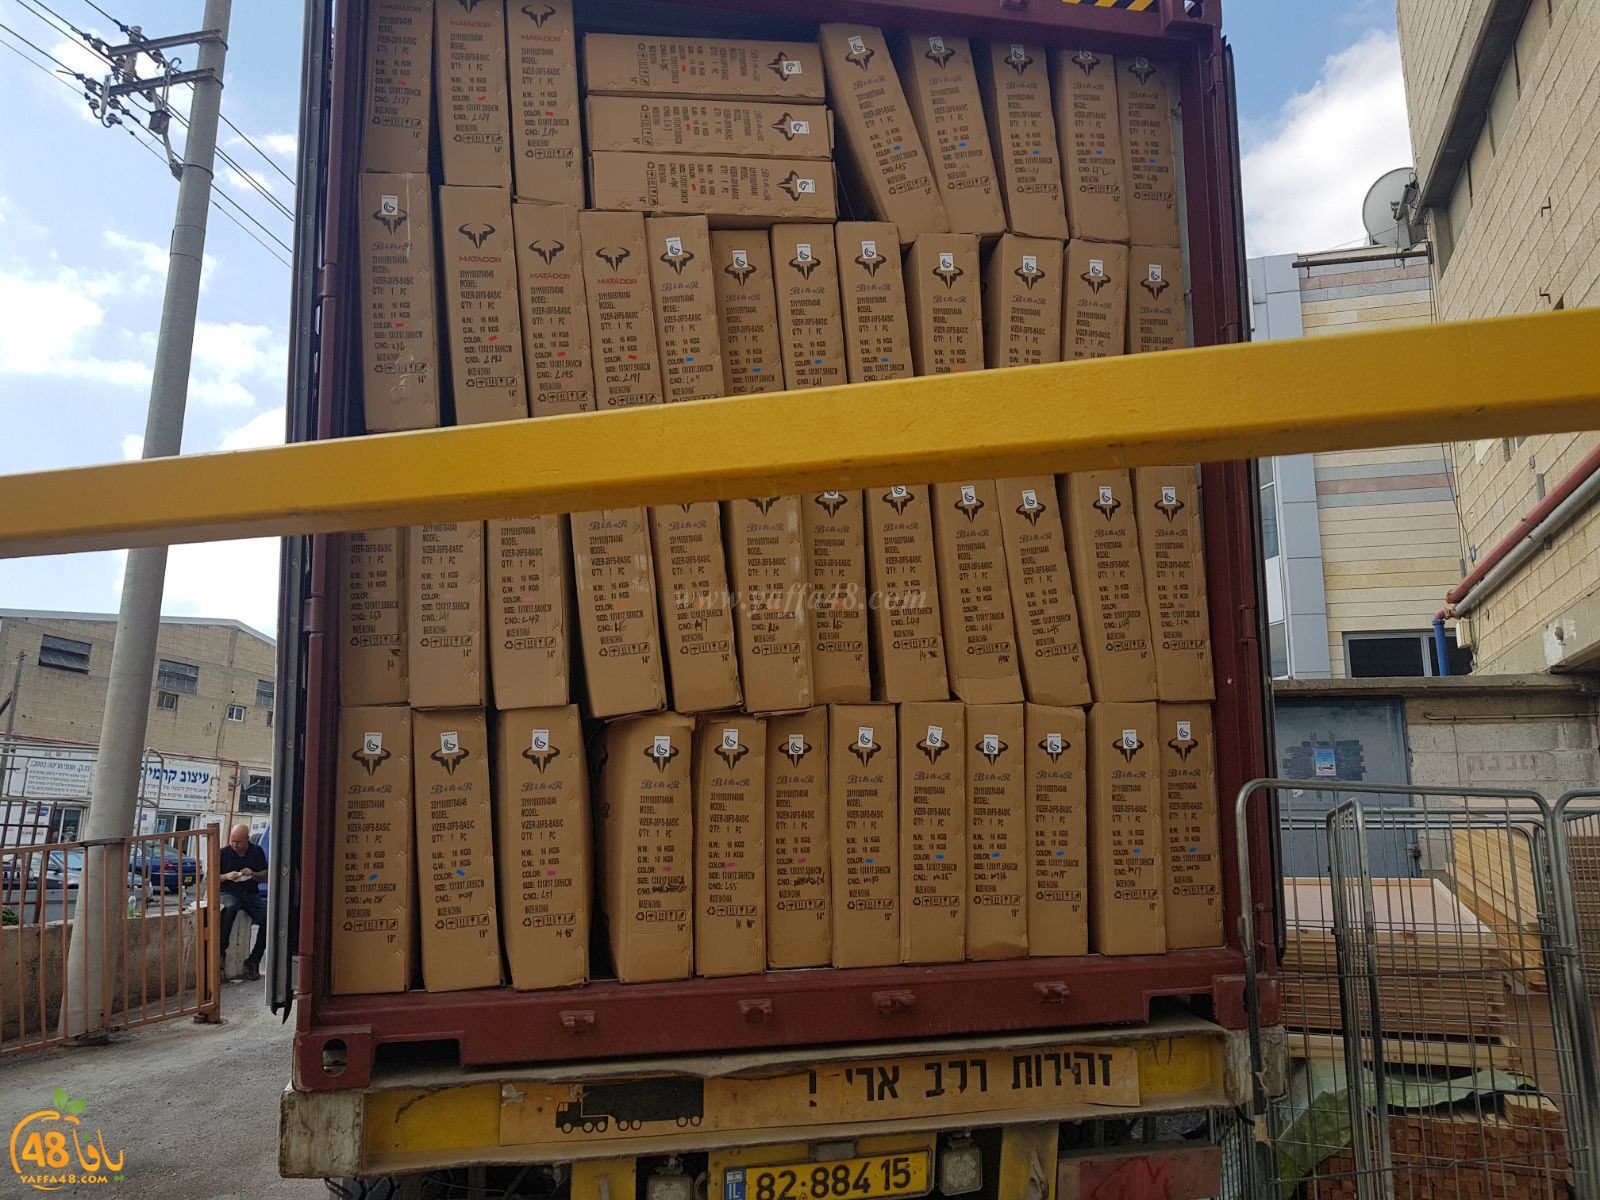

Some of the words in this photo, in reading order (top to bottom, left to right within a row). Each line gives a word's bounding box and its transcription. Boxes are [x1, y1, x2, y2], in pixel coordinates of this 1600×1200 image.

[520, 34, 562, 42] MATADOR
[180, 770, 210, 784] עיצוב
[1012, 1052, 1112, 1090] זהירות
